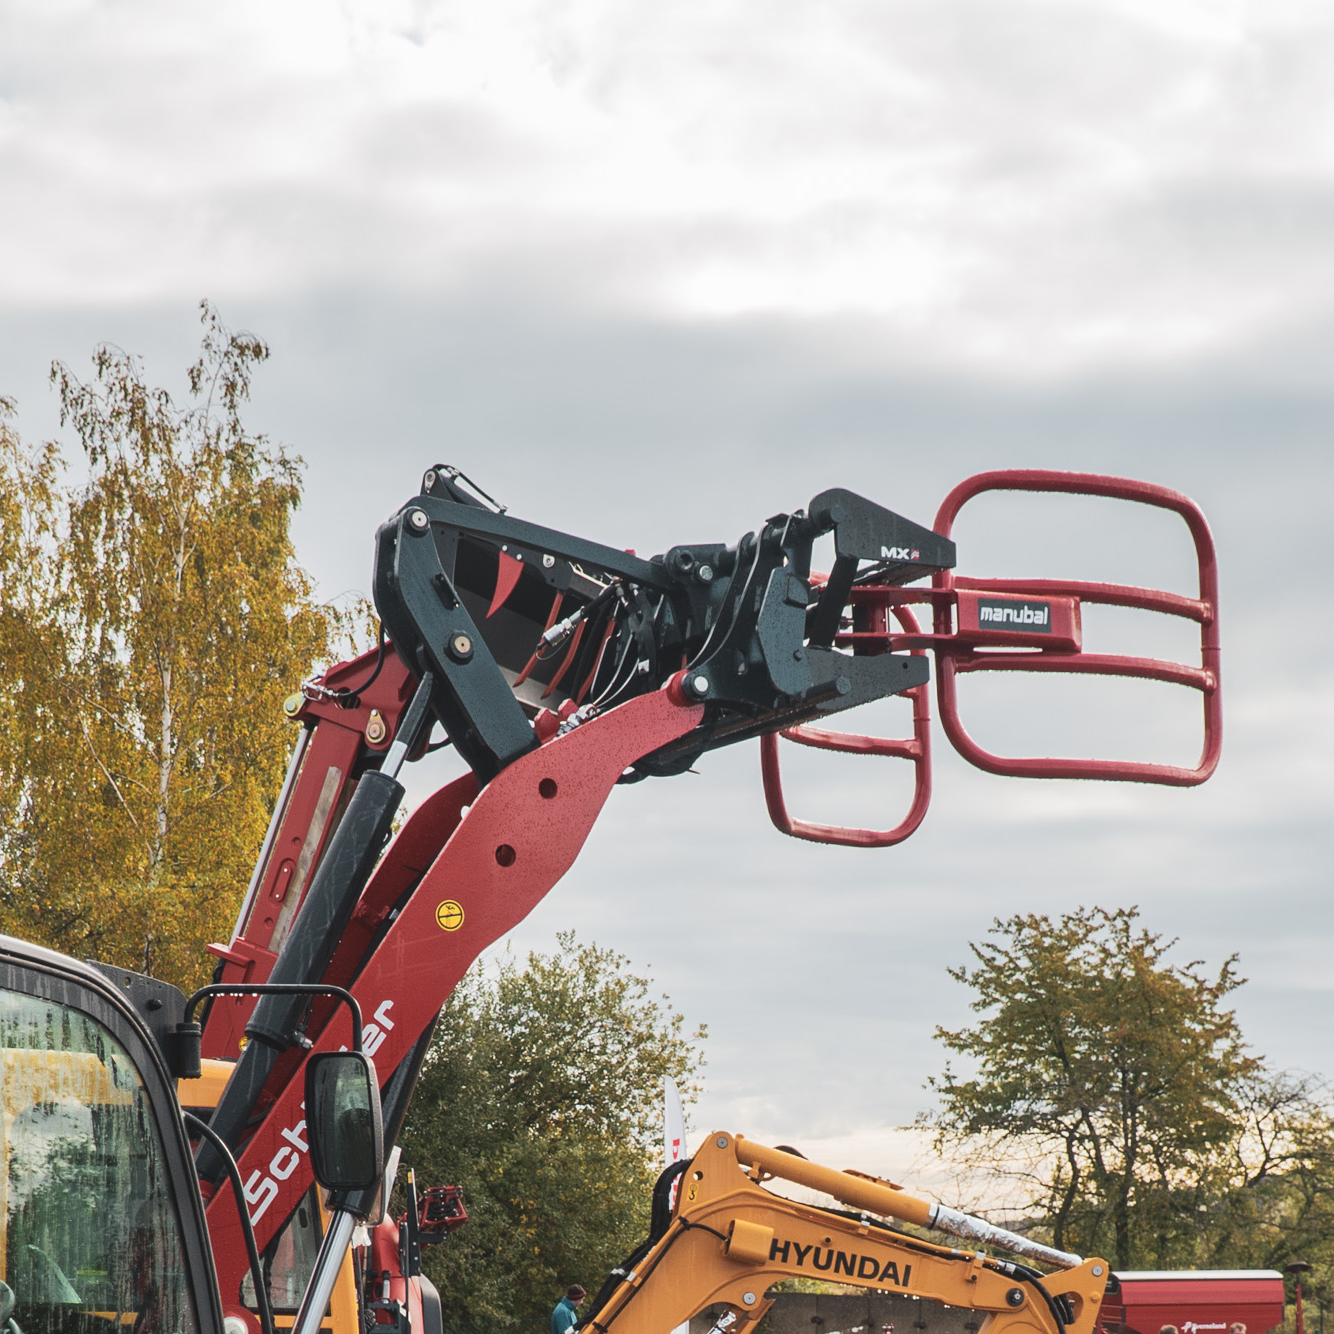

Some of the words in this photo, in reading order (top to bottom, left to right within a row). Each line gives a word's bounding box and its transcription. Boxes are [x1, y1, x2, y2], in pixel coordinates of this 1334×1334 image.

[880, 546, 910, 560] MX
[980, 604, 1049, 625] manubal
[243, 1000, 395, 1227] Scher
[769, 1238, 912, 1287] HYUNDAI
